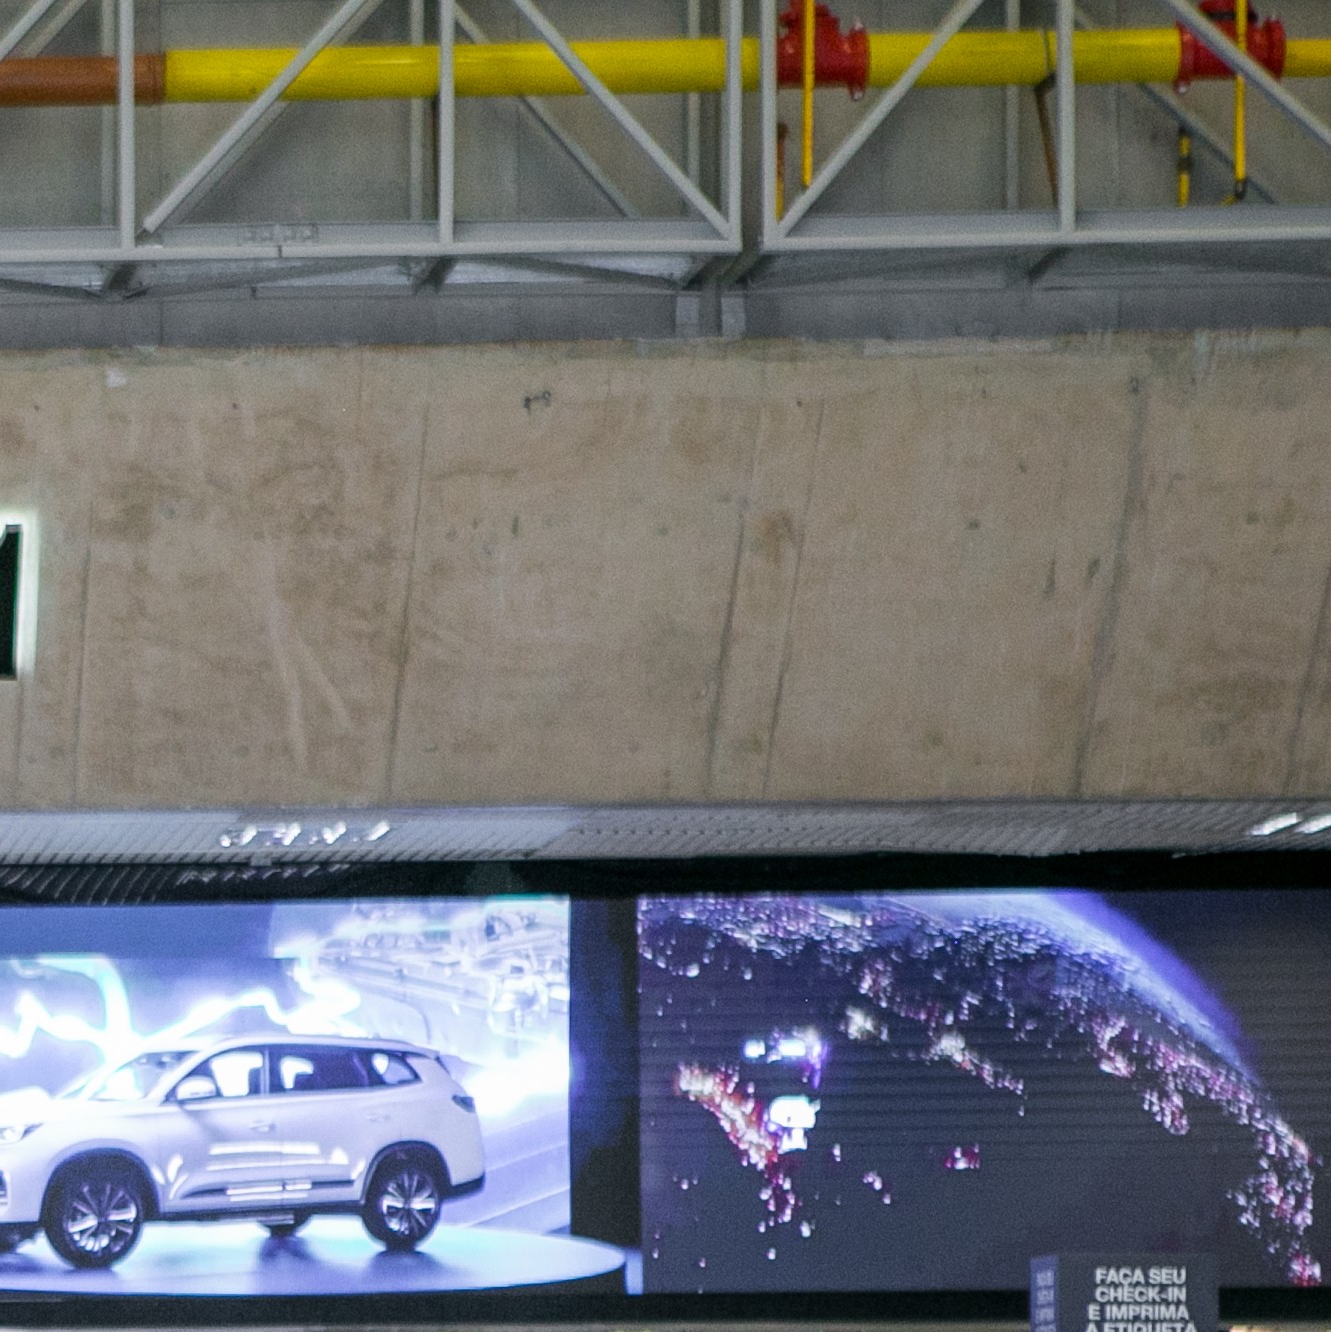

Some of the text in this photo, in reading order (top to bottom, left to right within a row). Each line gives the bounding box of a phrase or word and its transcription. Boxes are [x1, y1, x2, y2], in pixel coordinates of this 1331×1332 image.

[1095, 1267, 1187, 1286] FAÇA SEU
[1095, 1286, 1187, 1302] CHECK-IN
[1088, 1305, 1189, 1320] E IMPRIMA
